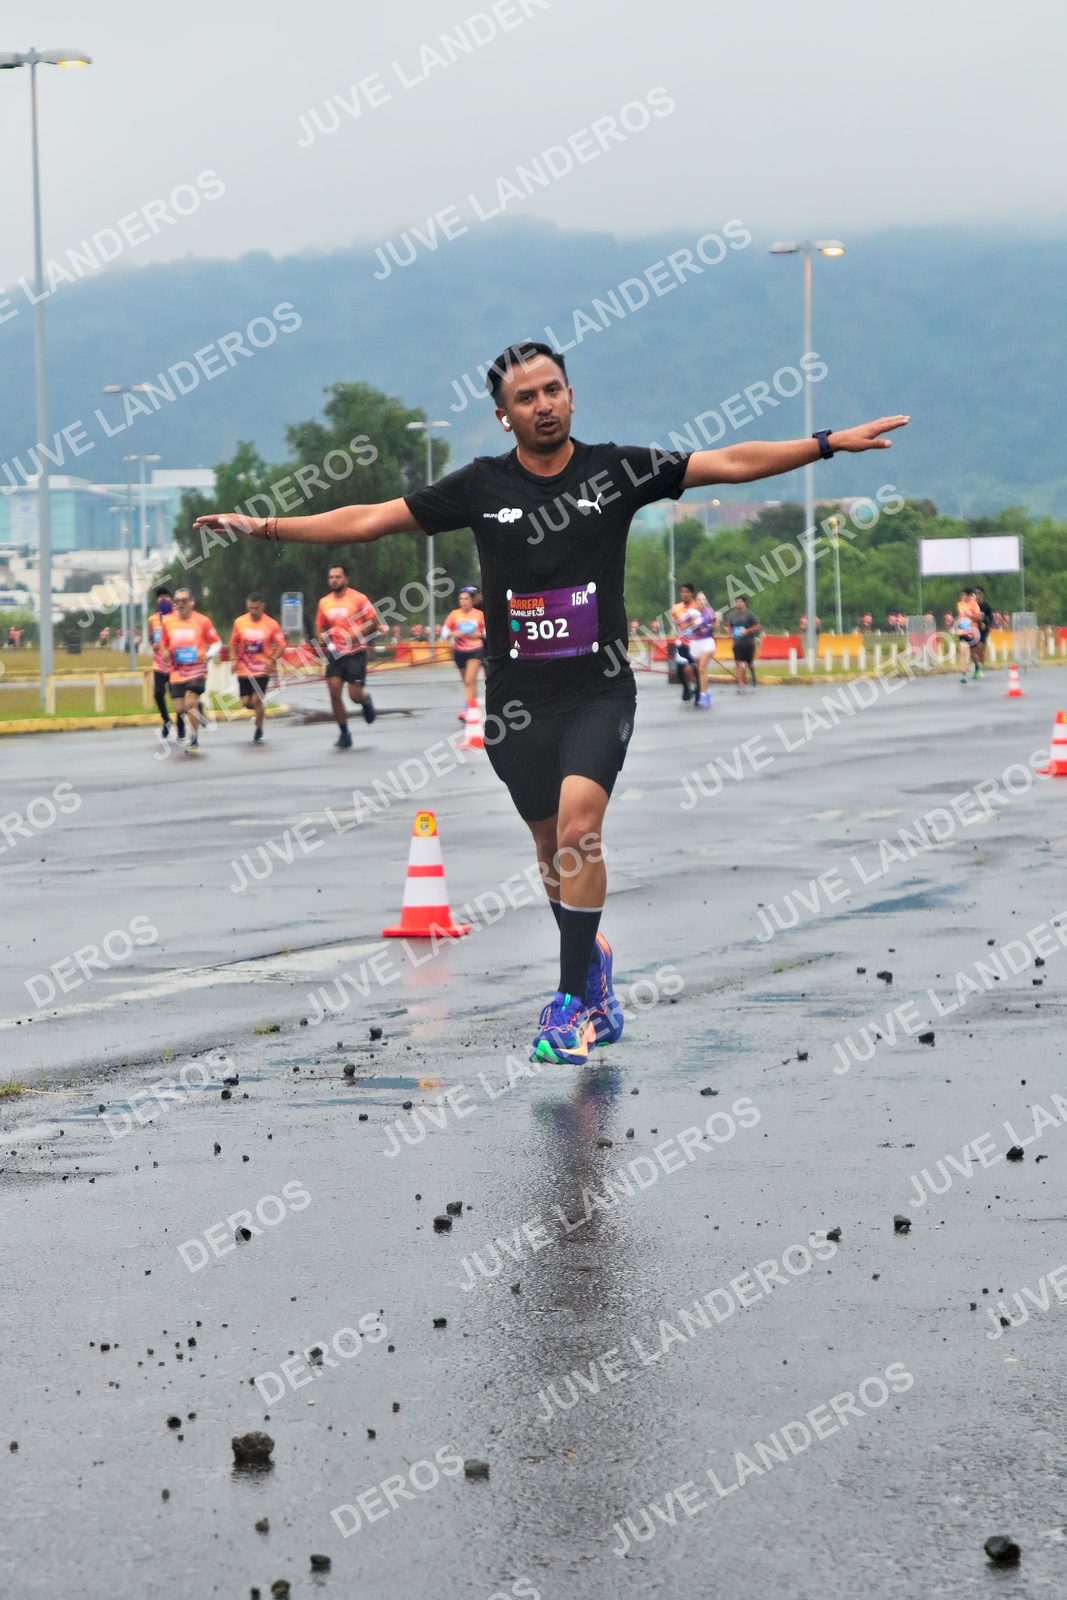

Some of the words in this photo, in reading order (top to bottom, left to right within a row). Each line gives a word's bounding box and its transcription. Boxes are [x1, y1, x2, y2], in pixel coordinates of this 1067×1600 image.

[497, 507, 523, 523] GP
[571, 590, 589, 606] 16K
[525, 618, 570, 640] 302
